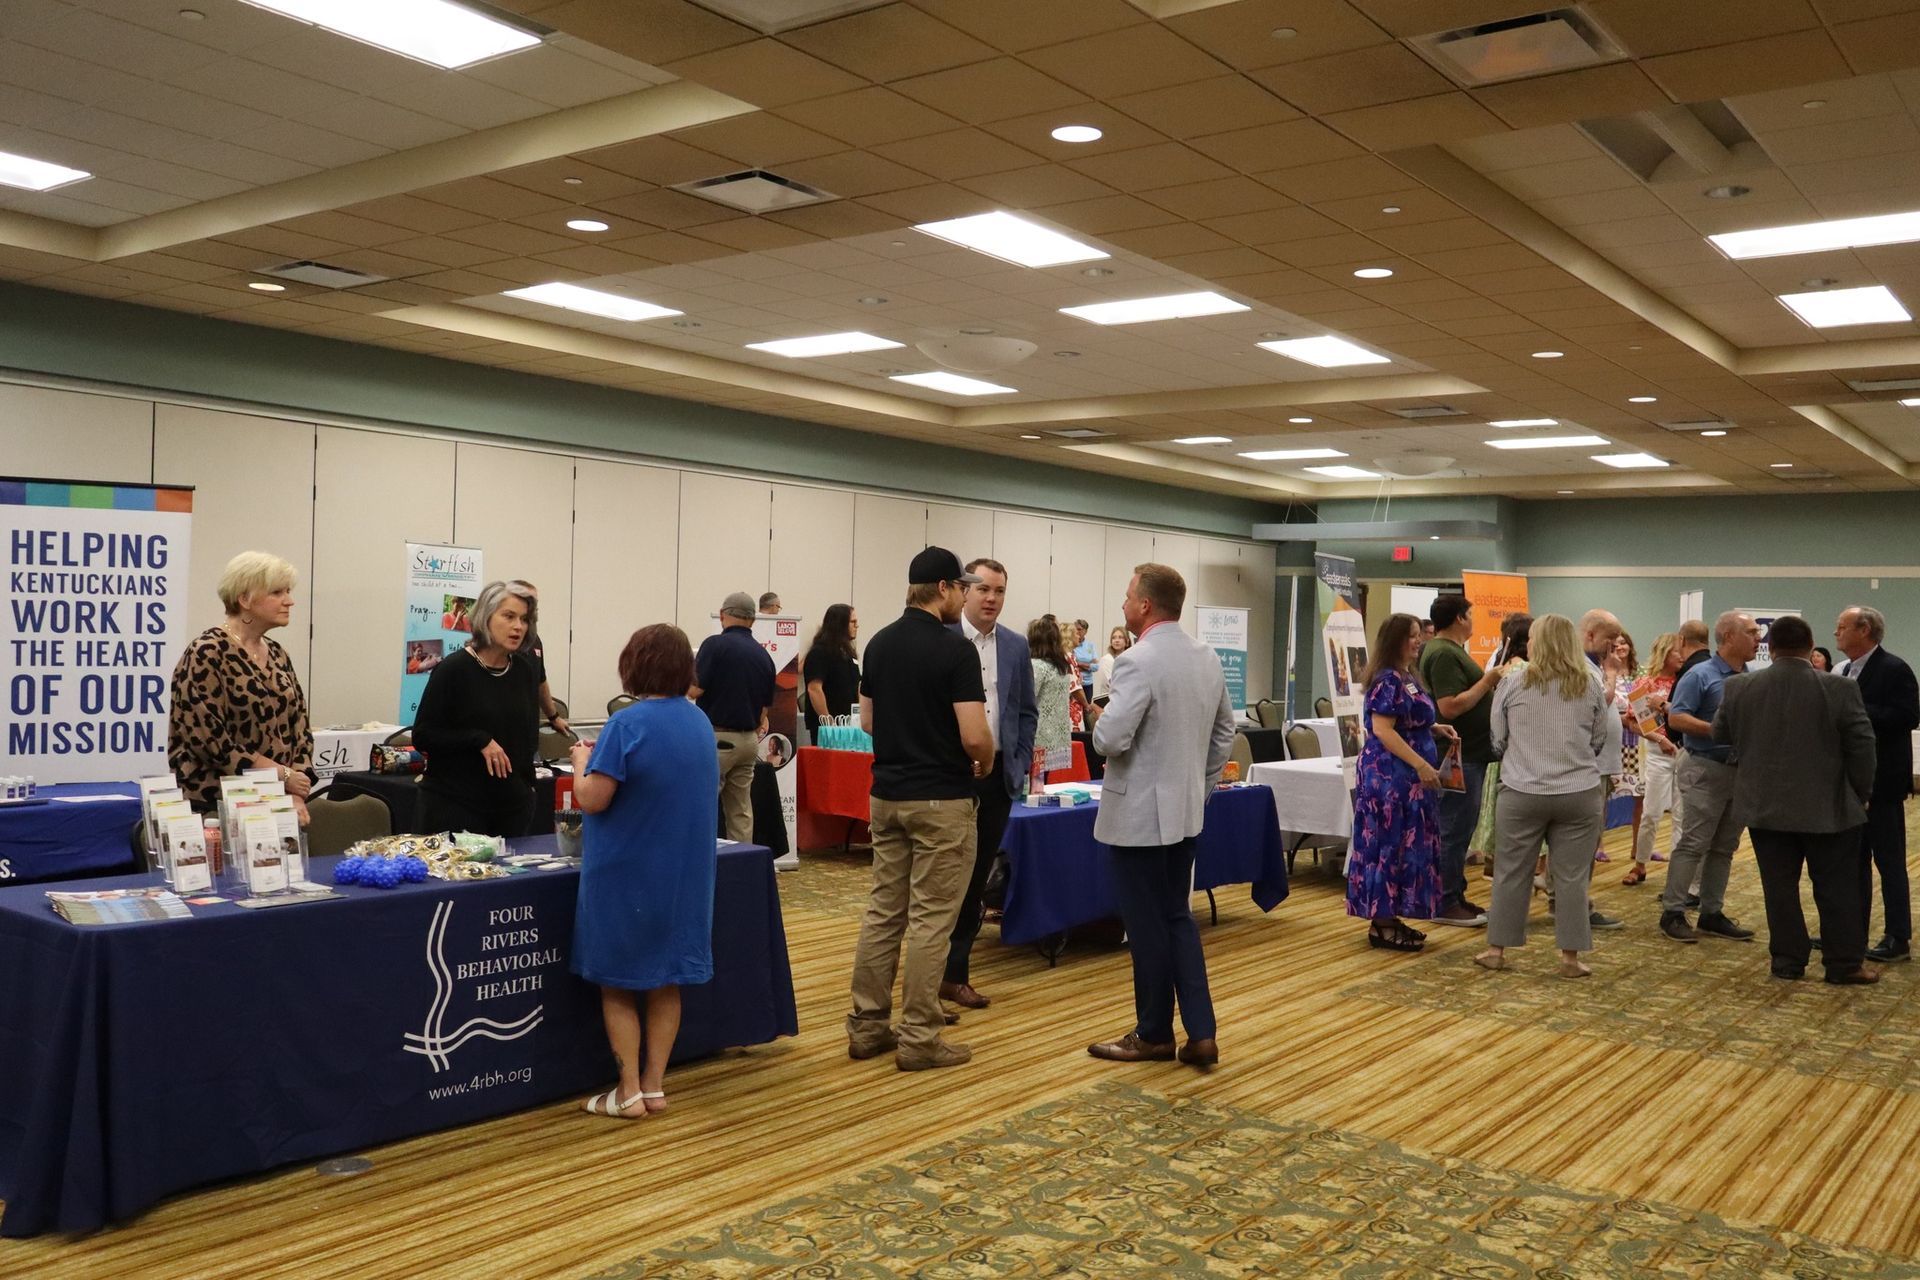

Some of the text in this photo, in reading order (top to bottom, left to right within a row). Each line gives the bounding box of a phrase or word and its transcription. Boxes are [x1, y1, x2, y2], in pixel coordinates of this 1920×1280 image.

[11, 530, 168, 569] HELPING
[11, 572, 167, 596] KENTUCKIANS
[1474, 593, 1527, 608] easterseals
[11, 600, 167, 635] WORK IS
[11, 640, 167, 667] THE HEART
[10, 674, 166, 715] OF OUR
[8, 721, 165, 755] MISSION.
[489, 905, 535, 926] FOUR
[481, 928, 539, 951] RIVERS
[457, 947, 562, 980] BEHAVIORAL
[476, 975, 543, 1001] HEALTH
[428, 1066, 532, 1101] www.4rbh.org
